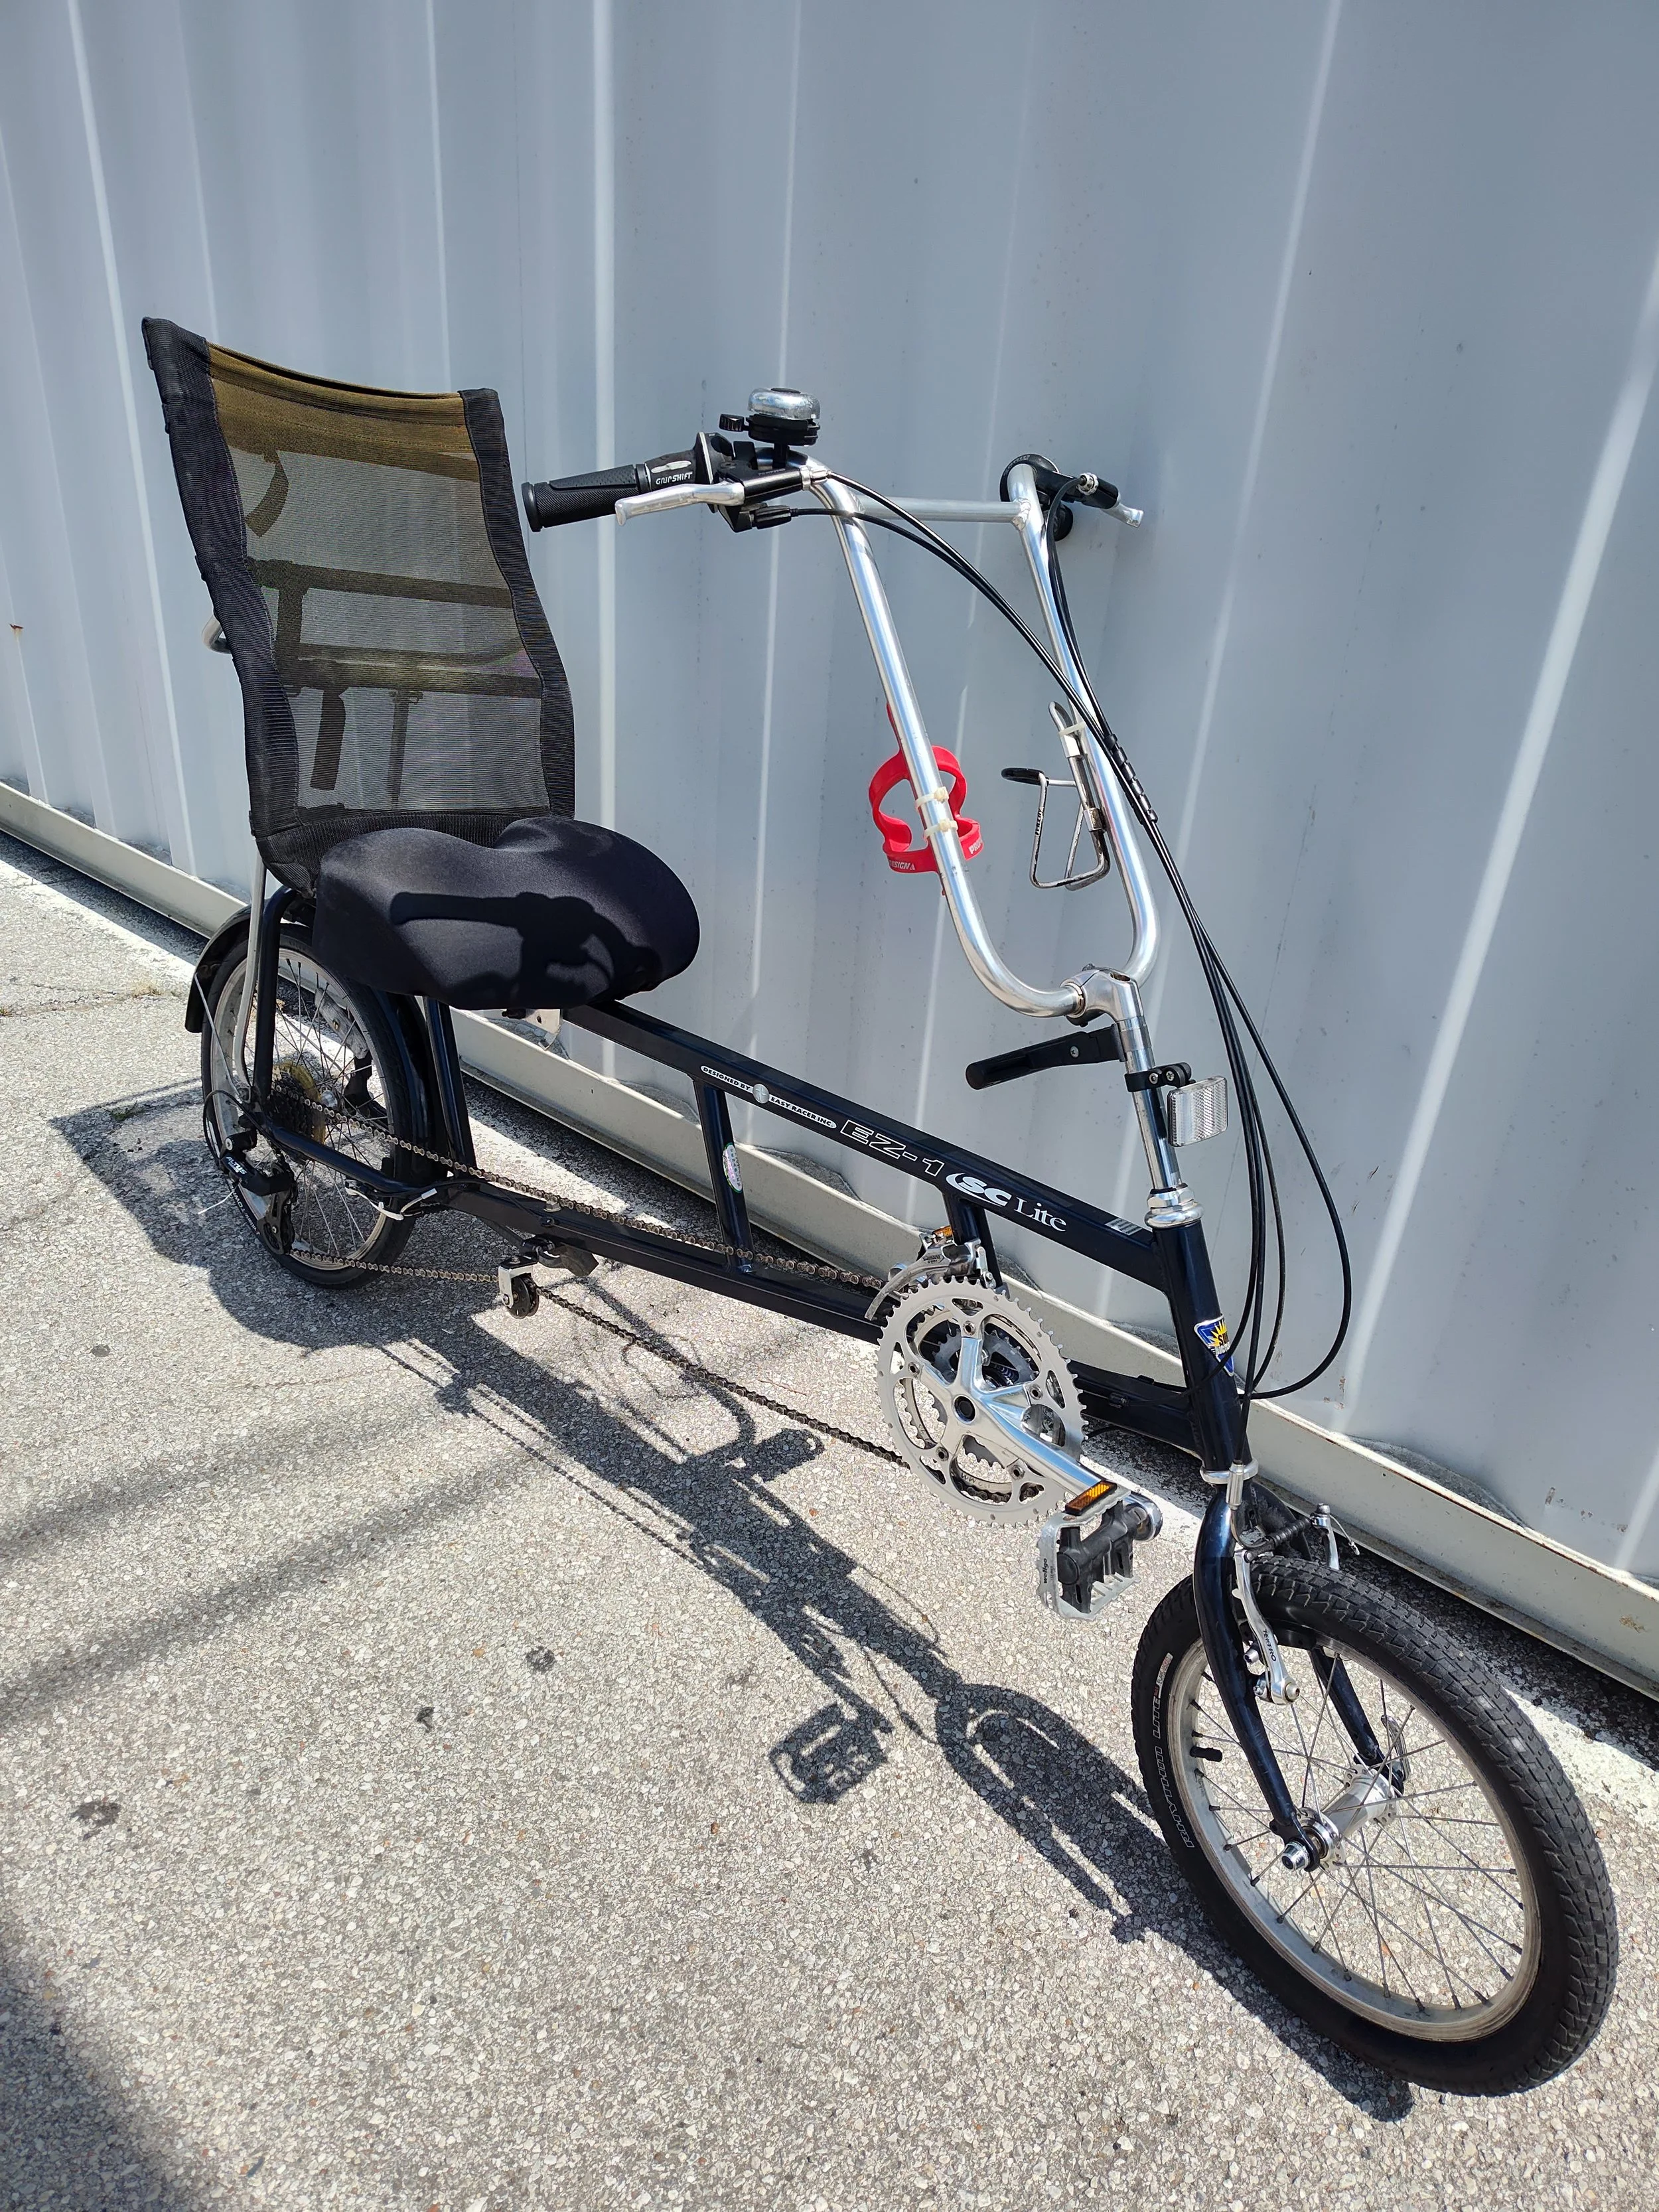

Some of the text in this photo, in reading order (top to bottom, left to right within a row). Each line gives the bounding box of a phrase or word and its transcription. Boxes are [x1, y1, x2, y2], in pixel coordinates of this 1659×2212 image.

[703, 1067, 739, 1086] DESIGNED
[771, 1096, 790, 1108] EASY
[791, 1105, 816, 1120] RACER
[226, 1157, 247, 1175] ALTUS
[839, 1120, 944, 1177] EZ-1
[1013, 1196, 1067, 1232] Lite
[1263, 1629, 1277, 1662] TEKTRO
[1152, 1696, 1194, 1848] RHYTHM LITE
